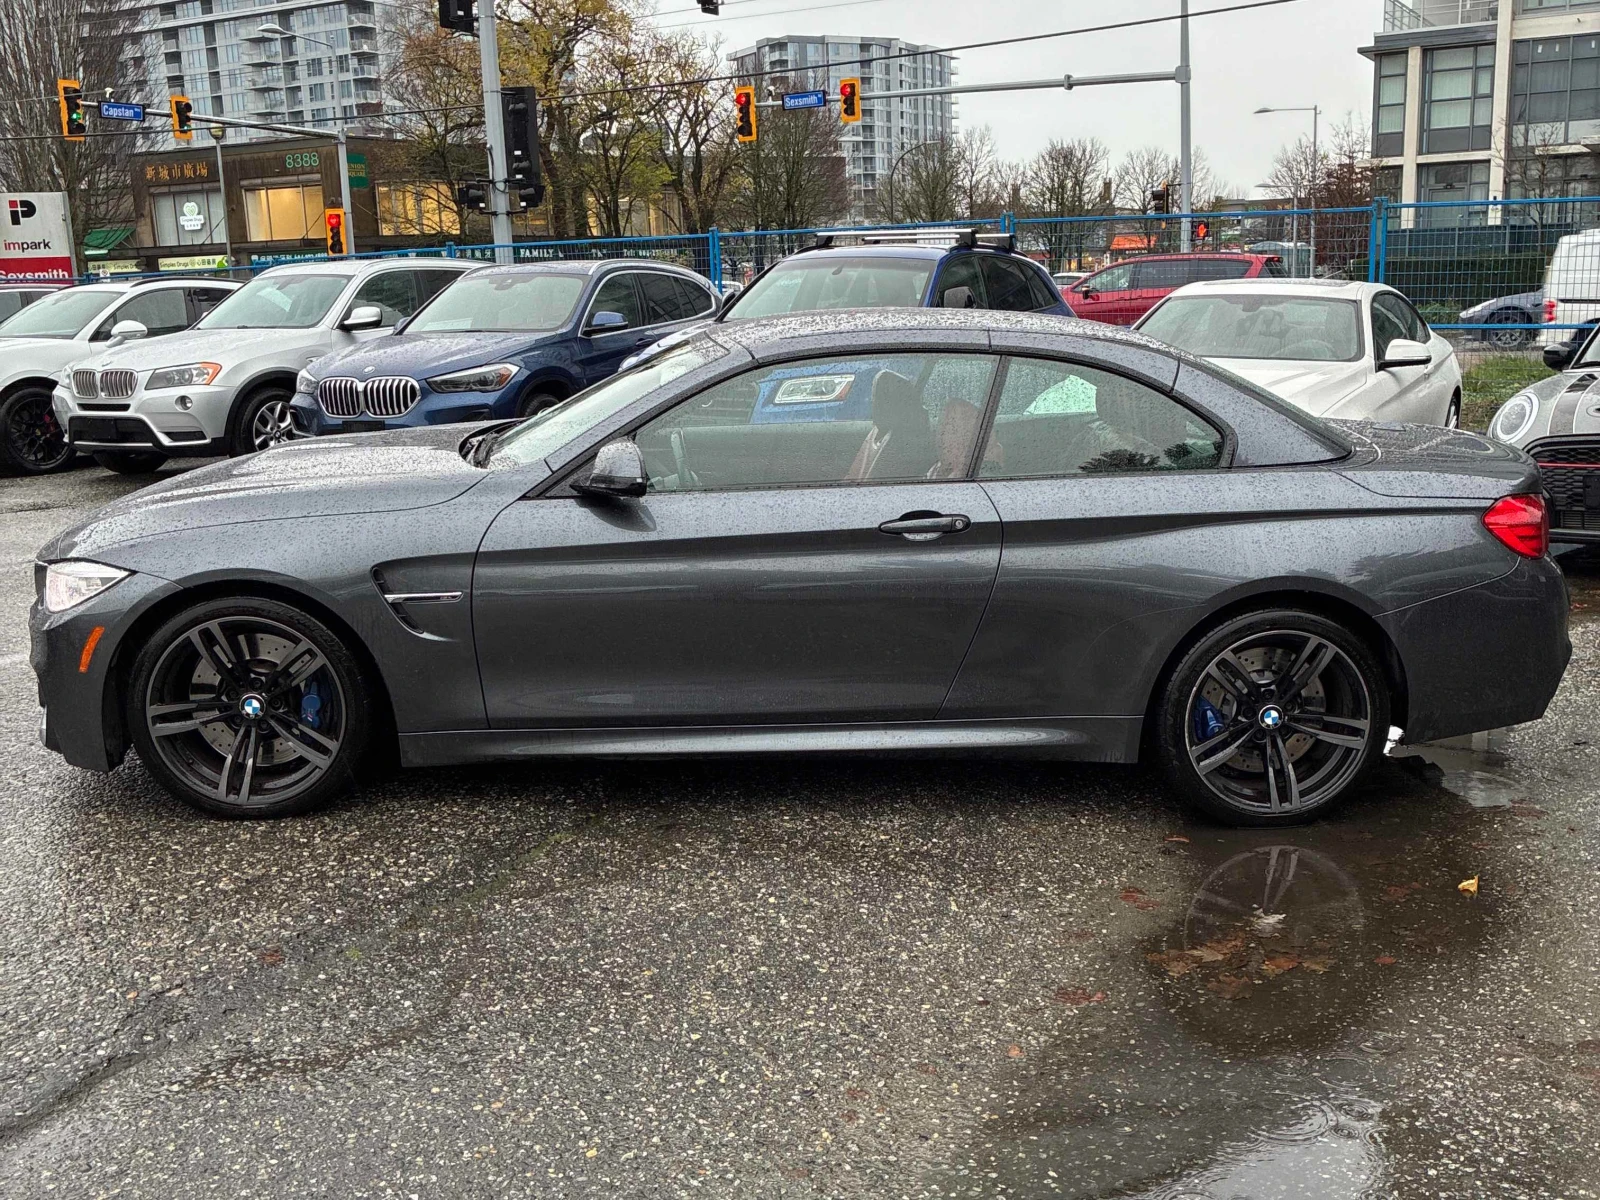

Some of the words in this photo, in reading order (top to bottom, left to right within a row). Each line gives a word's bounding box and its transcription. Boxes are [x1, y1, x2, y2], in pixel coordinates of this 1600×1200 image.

[785, 94, 818, 107] Sexsmith
[103, 104, 134, 117] Capstan
[286, 152, 319, 168] 8388
[3, 238, 52, 253] impark
[520, 248, 554, 258] FAMILY
